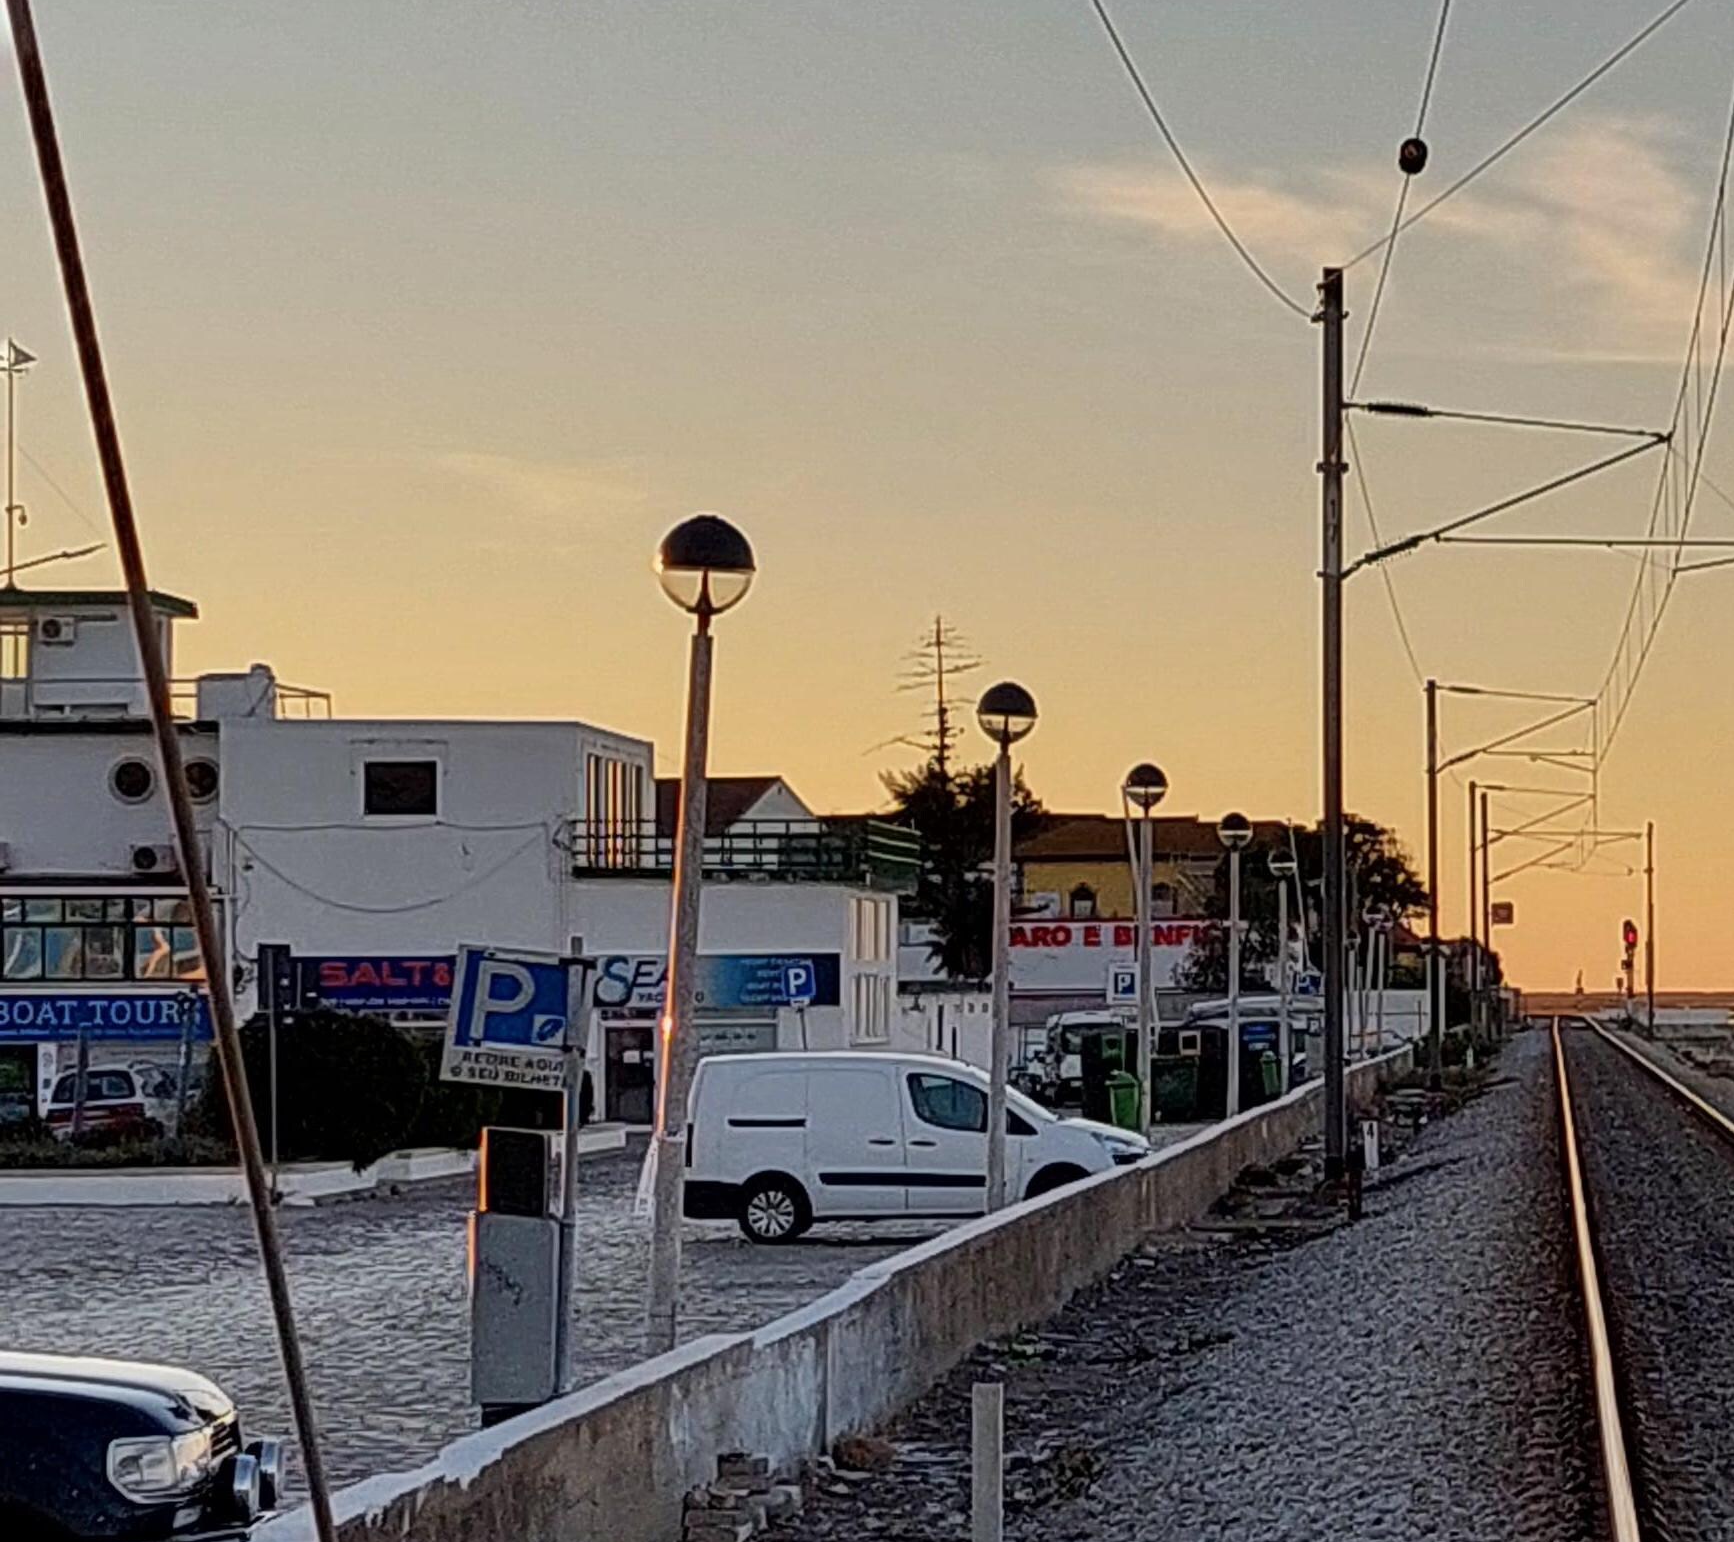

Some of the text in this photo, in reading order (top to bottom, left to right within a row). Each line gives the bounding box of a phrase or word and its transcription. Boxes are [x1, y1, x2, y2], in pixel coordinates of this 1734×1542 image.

[1008, 925, 1072, 947] ARO
[1083, 924, 1101, 947] E
[787, 968, 807, 995] P
[1118, 974, 1131, 993] P
[469, 961, 535, 1039] P
